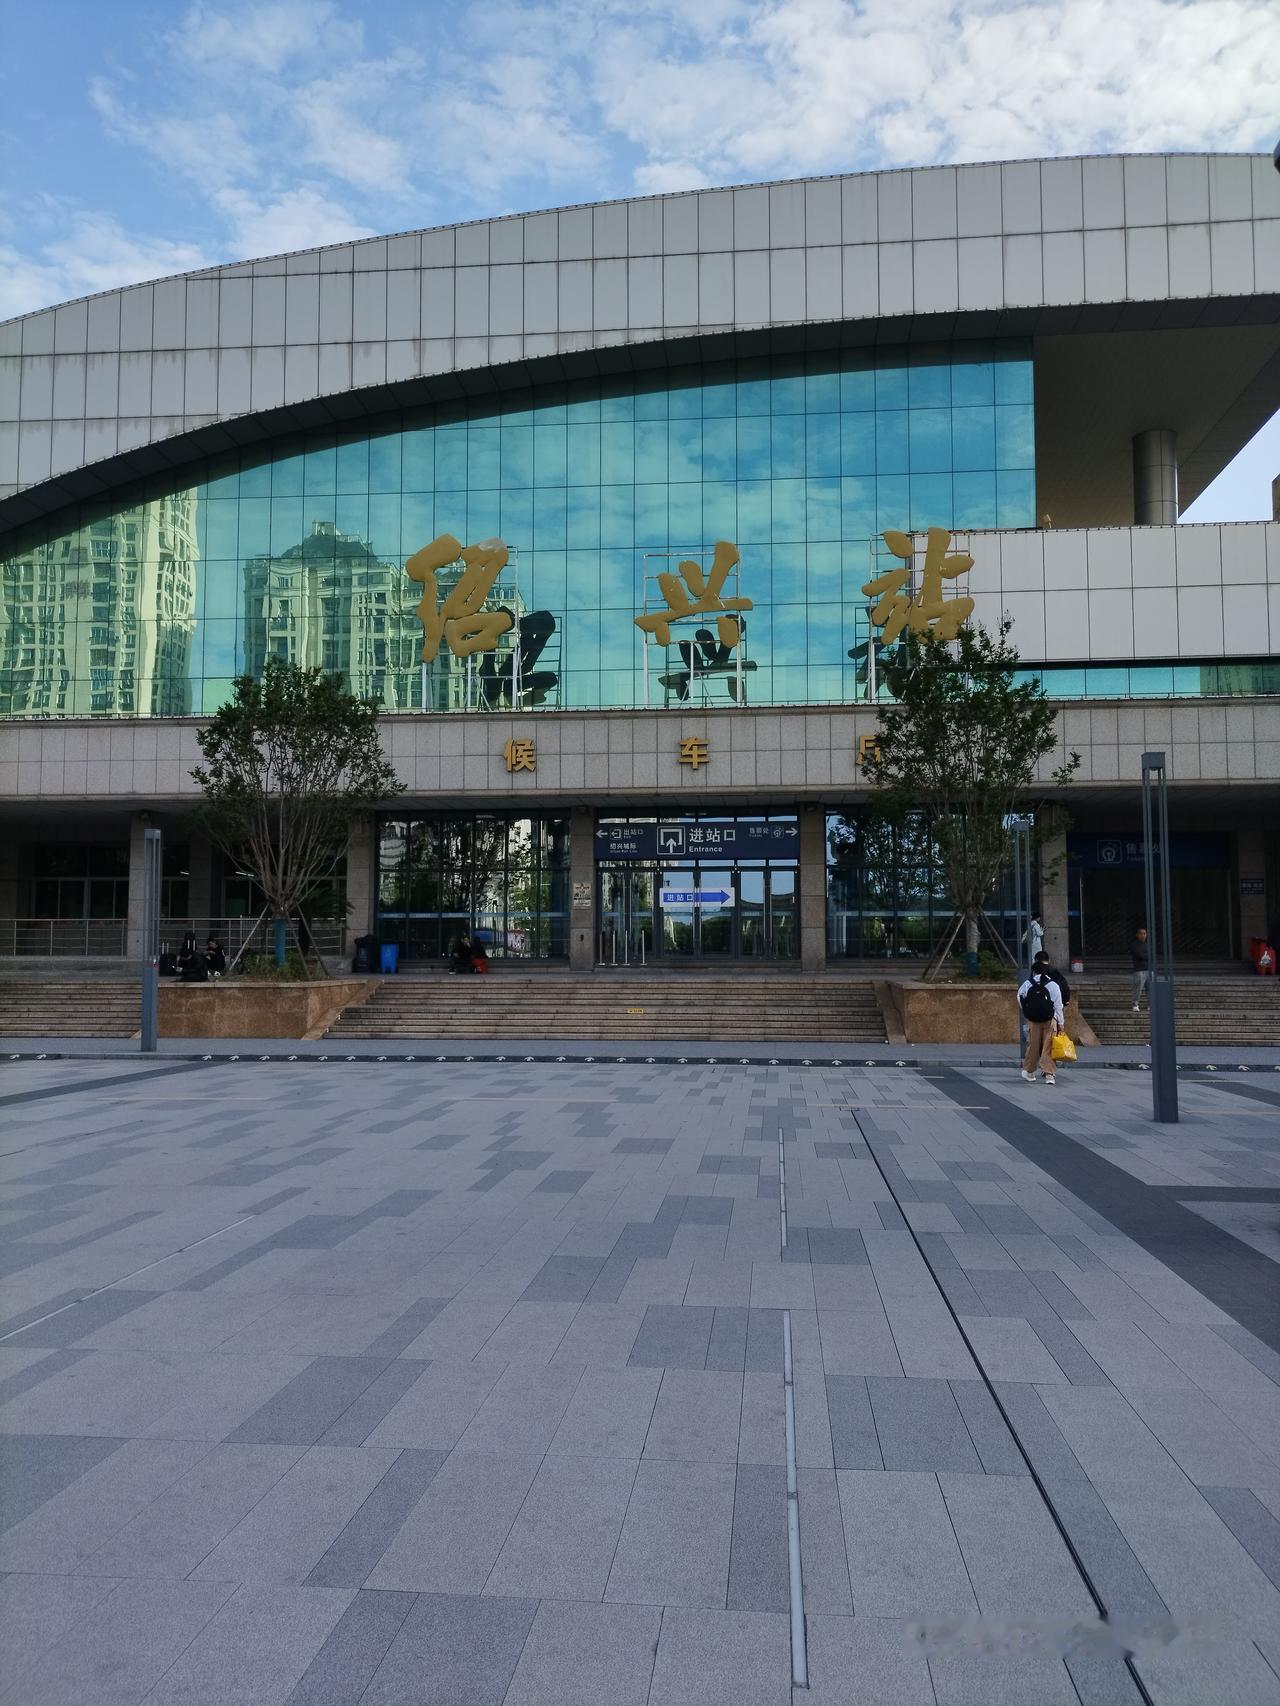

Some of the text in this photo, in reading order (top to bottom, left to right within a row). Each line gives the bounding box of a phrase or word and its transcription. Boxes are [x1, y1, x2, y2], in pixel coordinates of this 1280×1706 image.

[689, 827, 736, 843] 进站口
[688, 845, 723, 853] Entrance
[666, 893, 694, 902] 进站口
